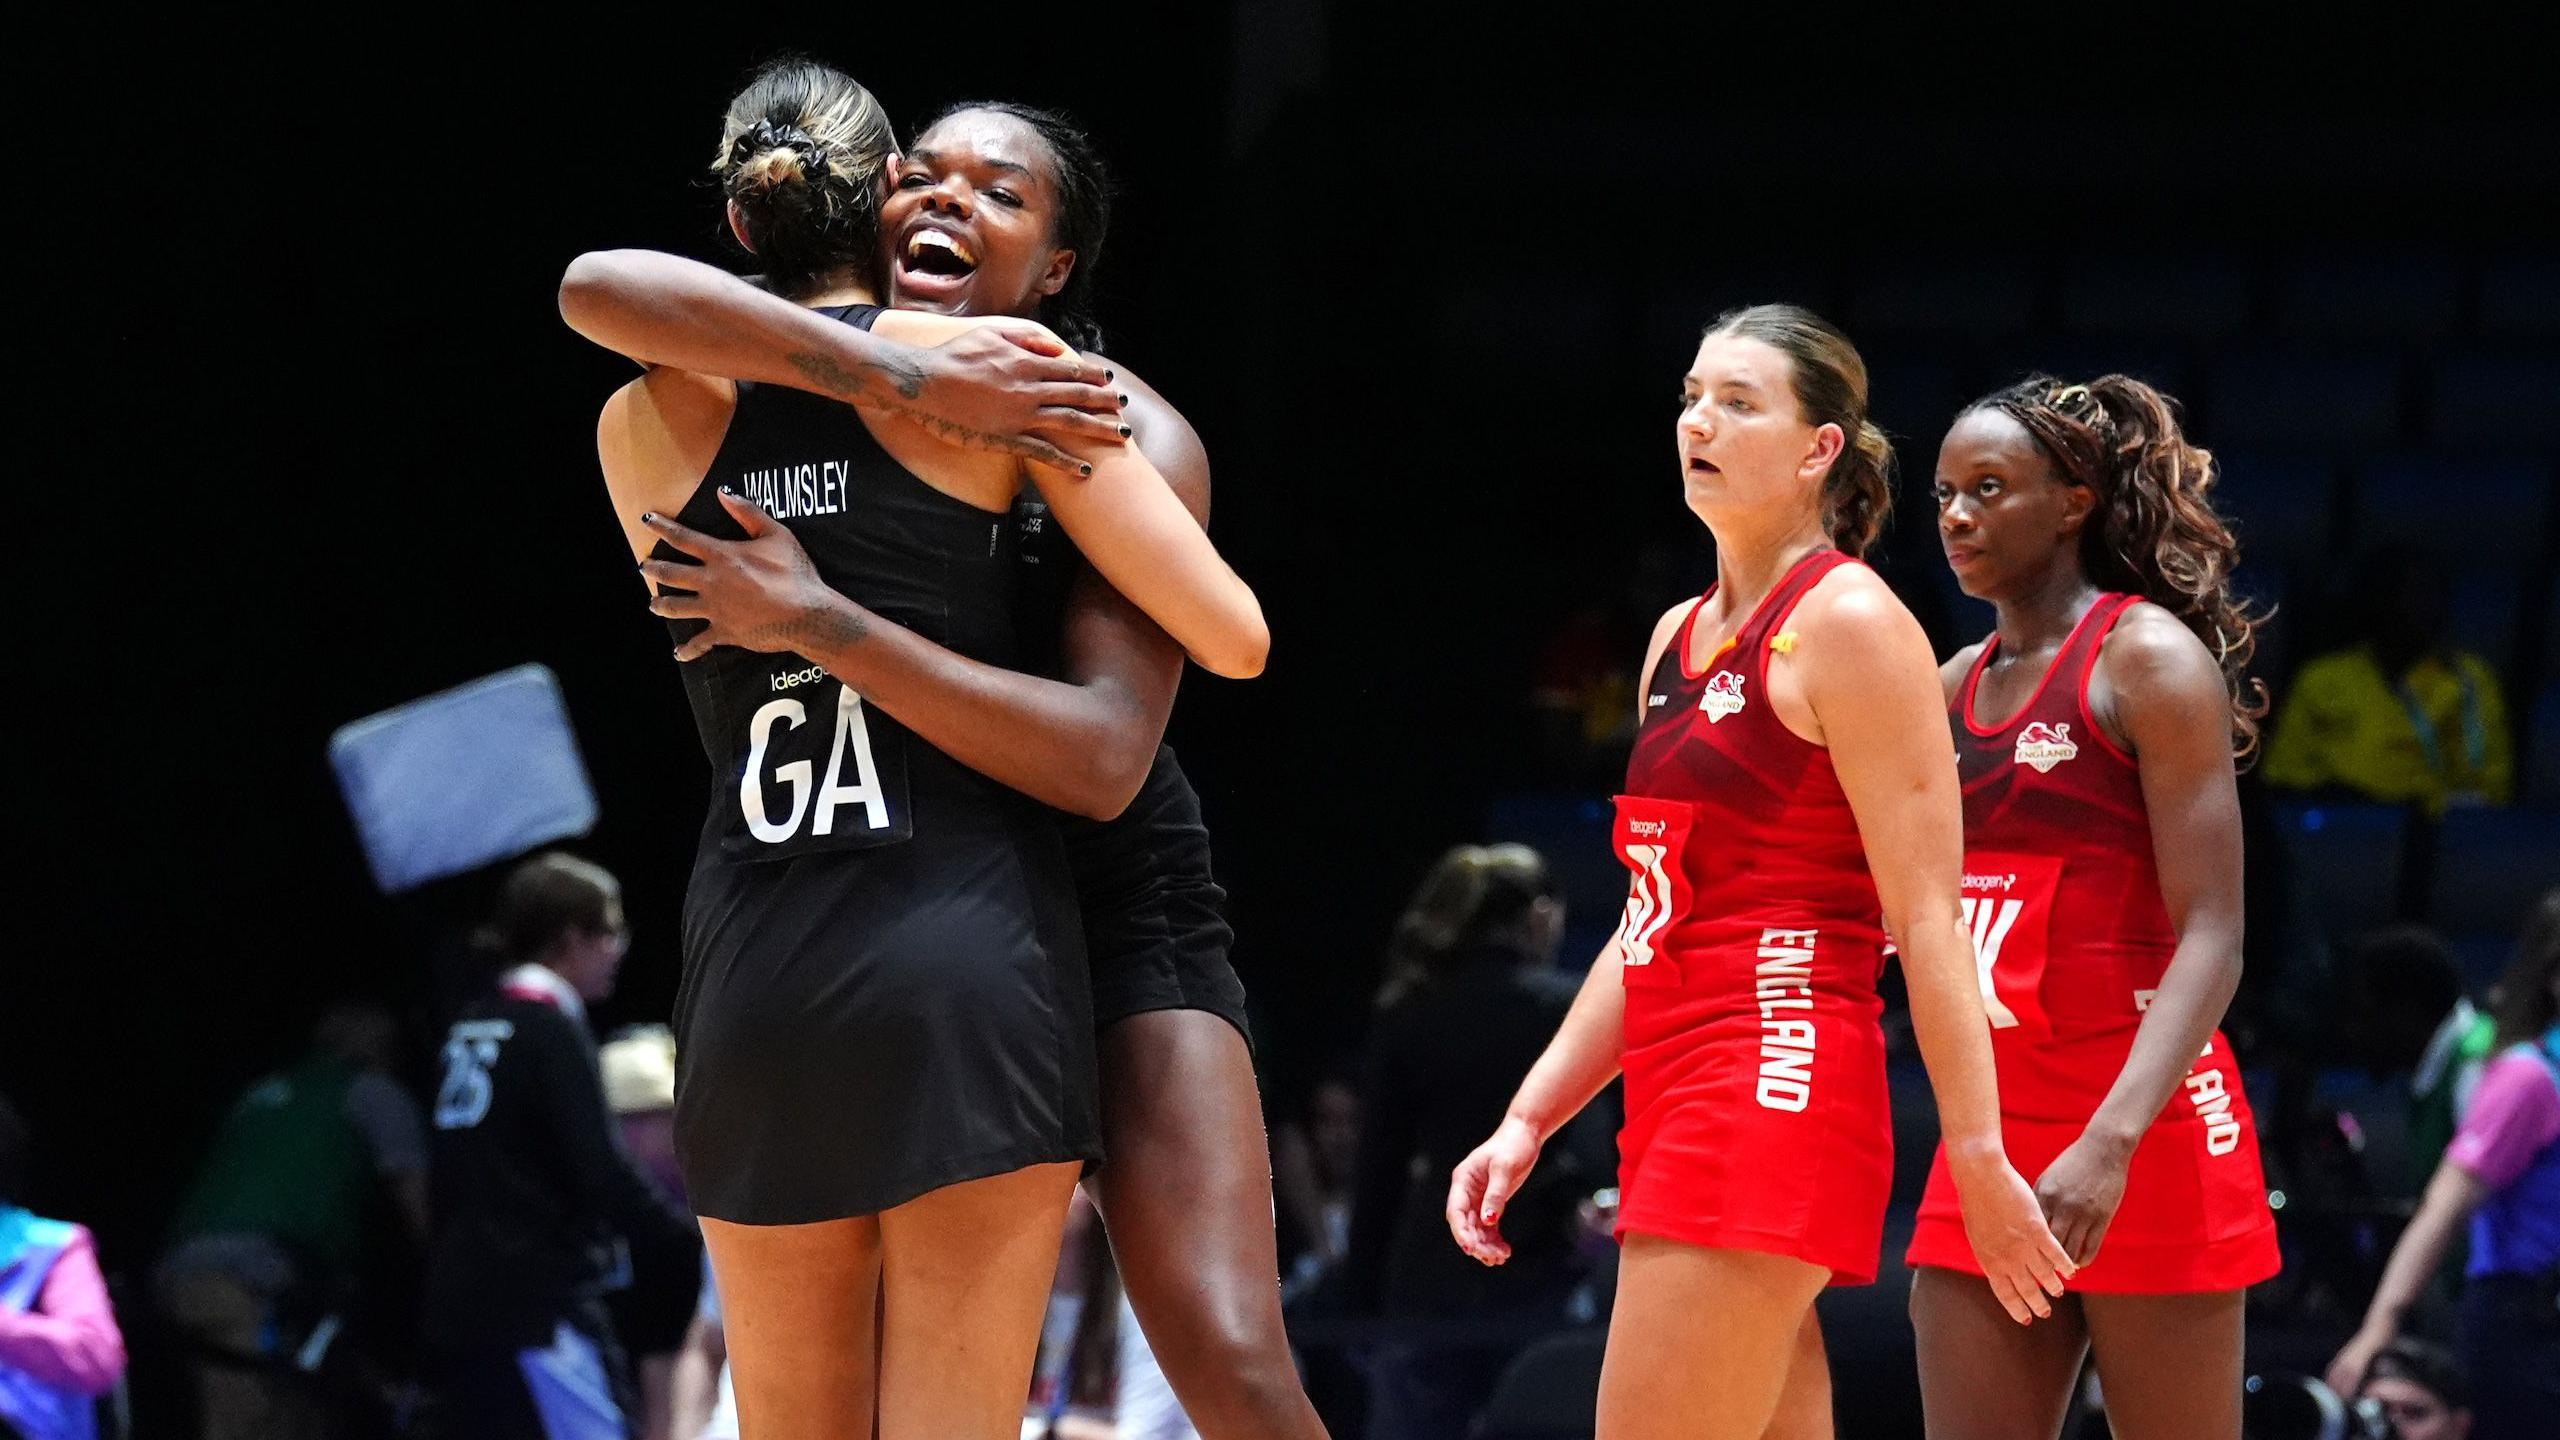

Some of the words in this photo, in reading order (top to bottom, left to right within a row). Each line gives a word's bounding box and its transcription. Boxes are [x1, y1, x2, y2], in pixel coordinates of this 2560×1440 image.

[743, 460, 849, 519] WALMSLEY
[740, 684, 890, 844] GA
[2018, 748, 2073, 760] ENGLAND
[1961, 873, 2004, 892] deagen
[1960, 898, 2024, 1030] K
[1755, 927, 1819, 1113] ENGLAND
